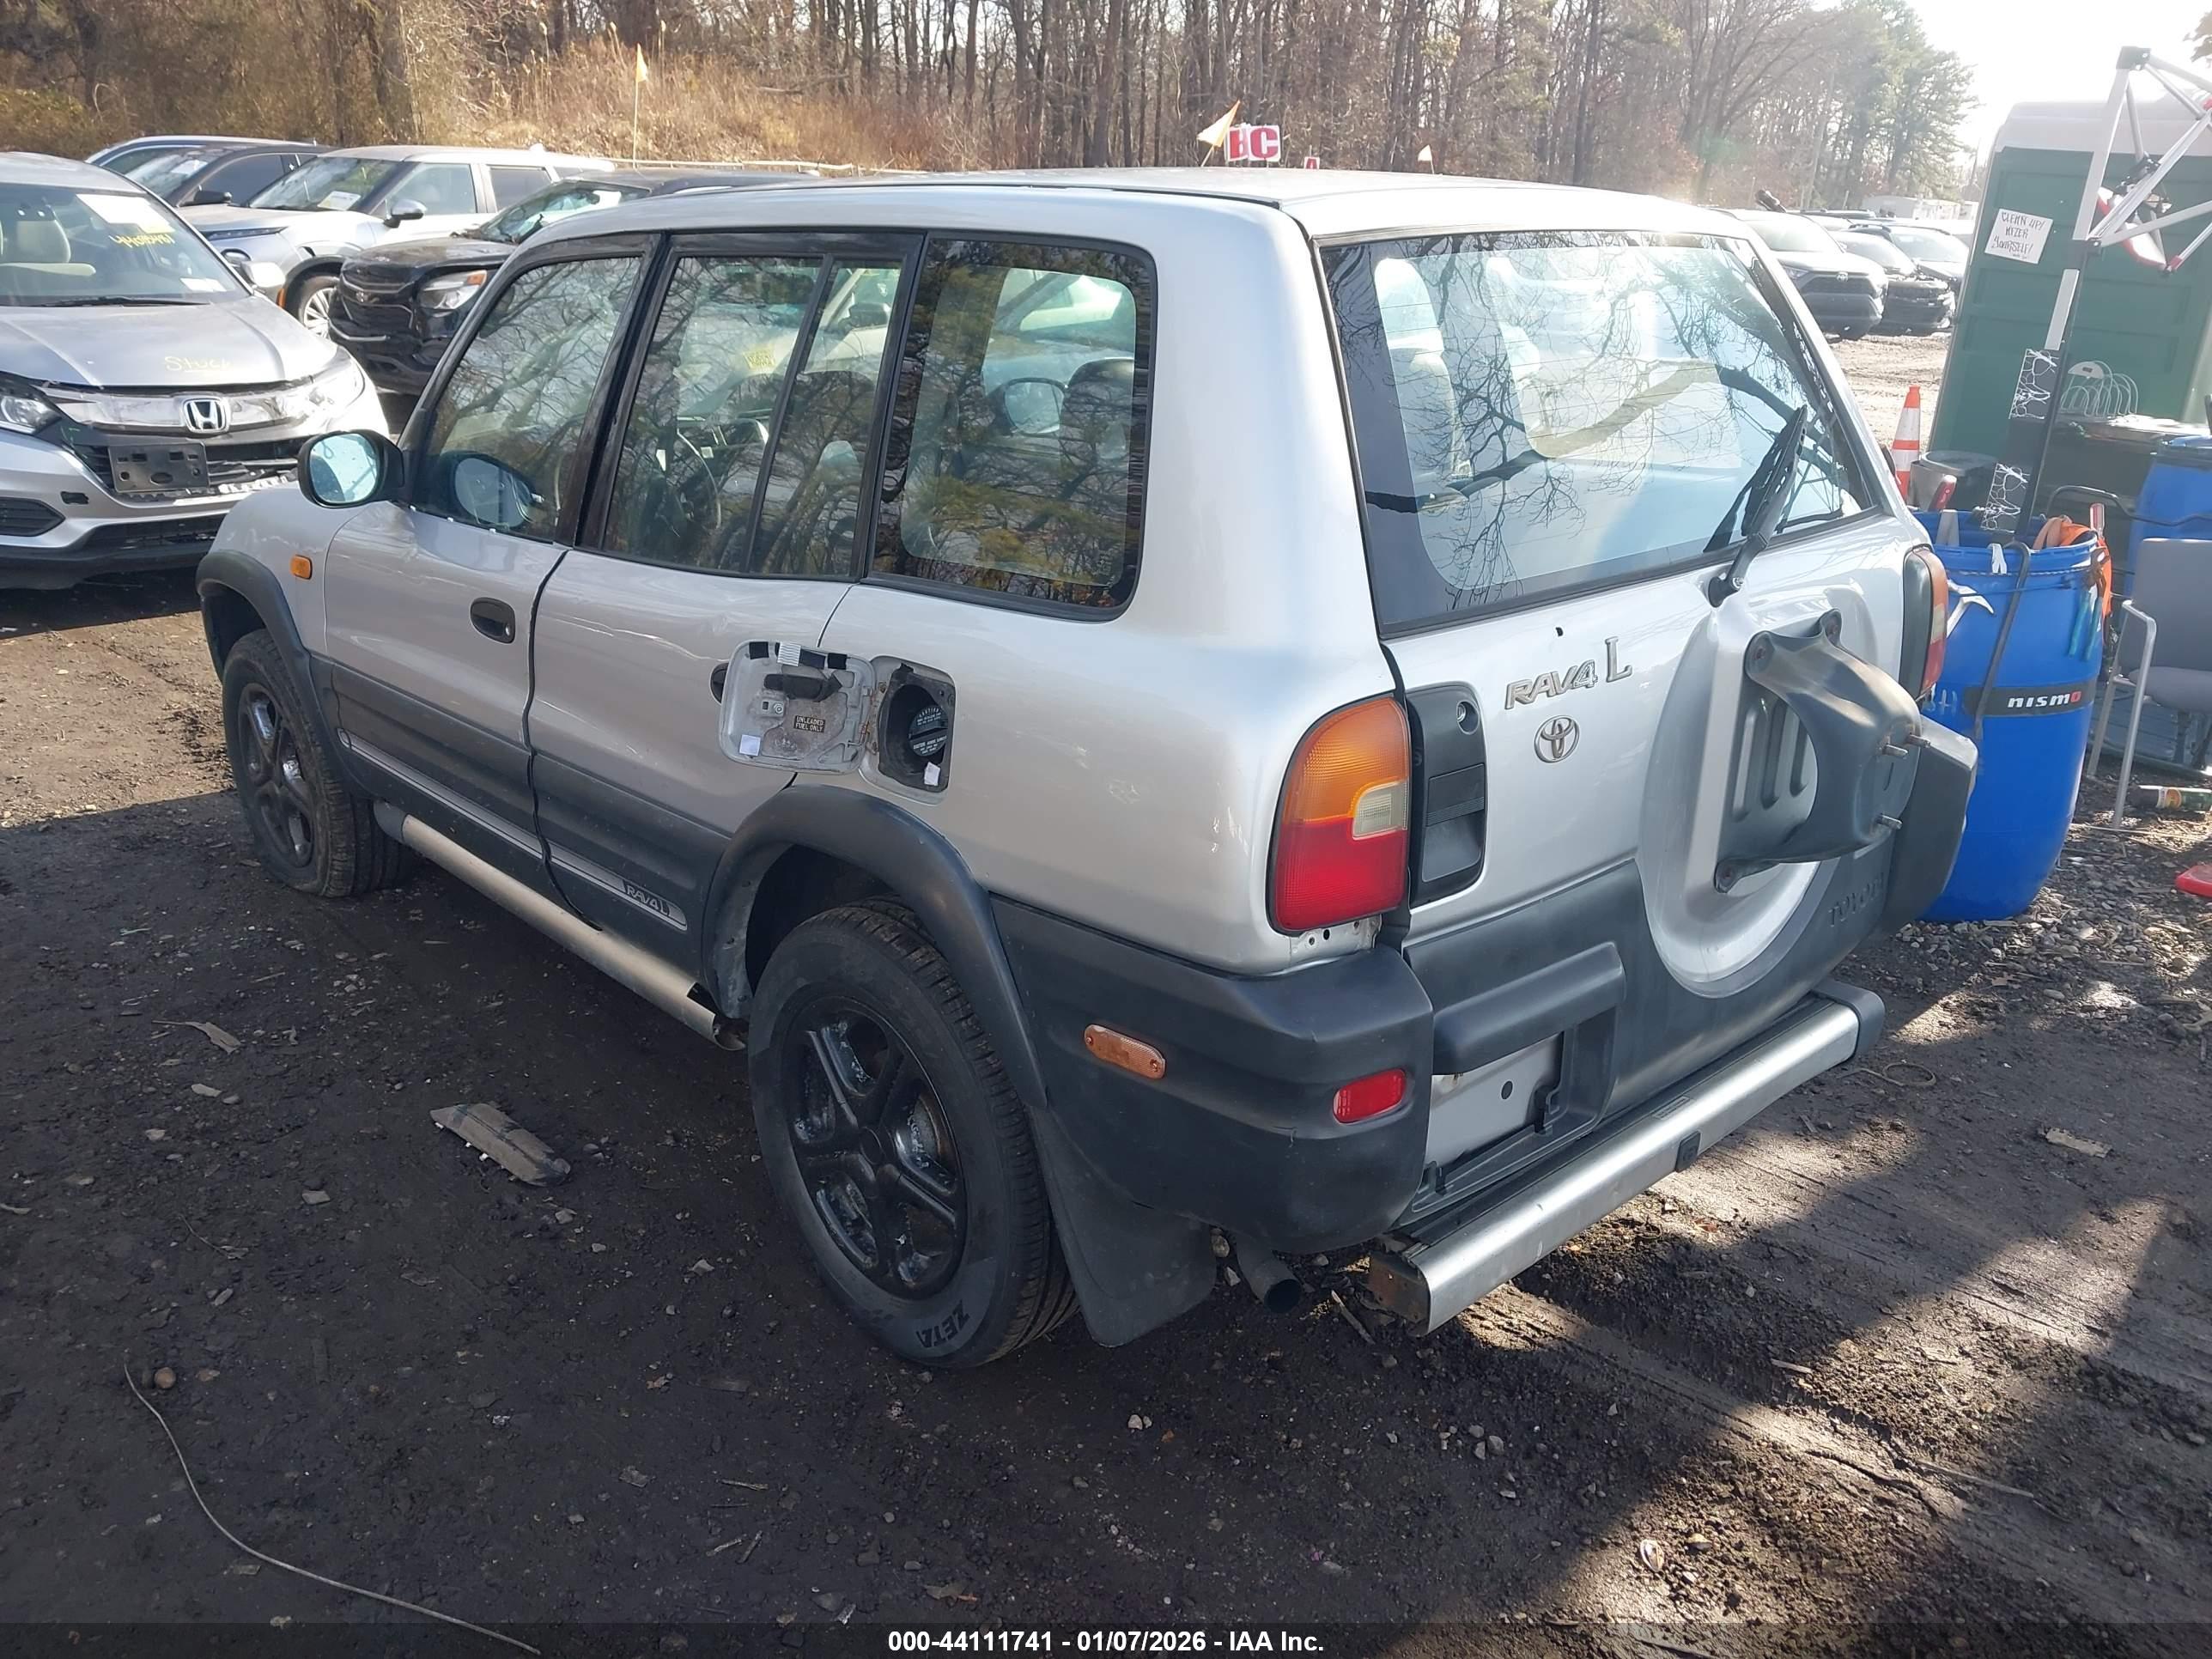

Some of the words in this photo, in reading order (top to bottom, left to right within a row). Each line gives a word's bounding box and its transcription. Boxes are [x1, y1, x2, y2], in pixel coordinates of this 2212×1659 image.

[1250, 127, 1279, 159] C
[1504, 659, 1598, 710] RAV4
[796, 715, 825, 726] UNLEADED
[810, 724, 824, 732] ONLY
